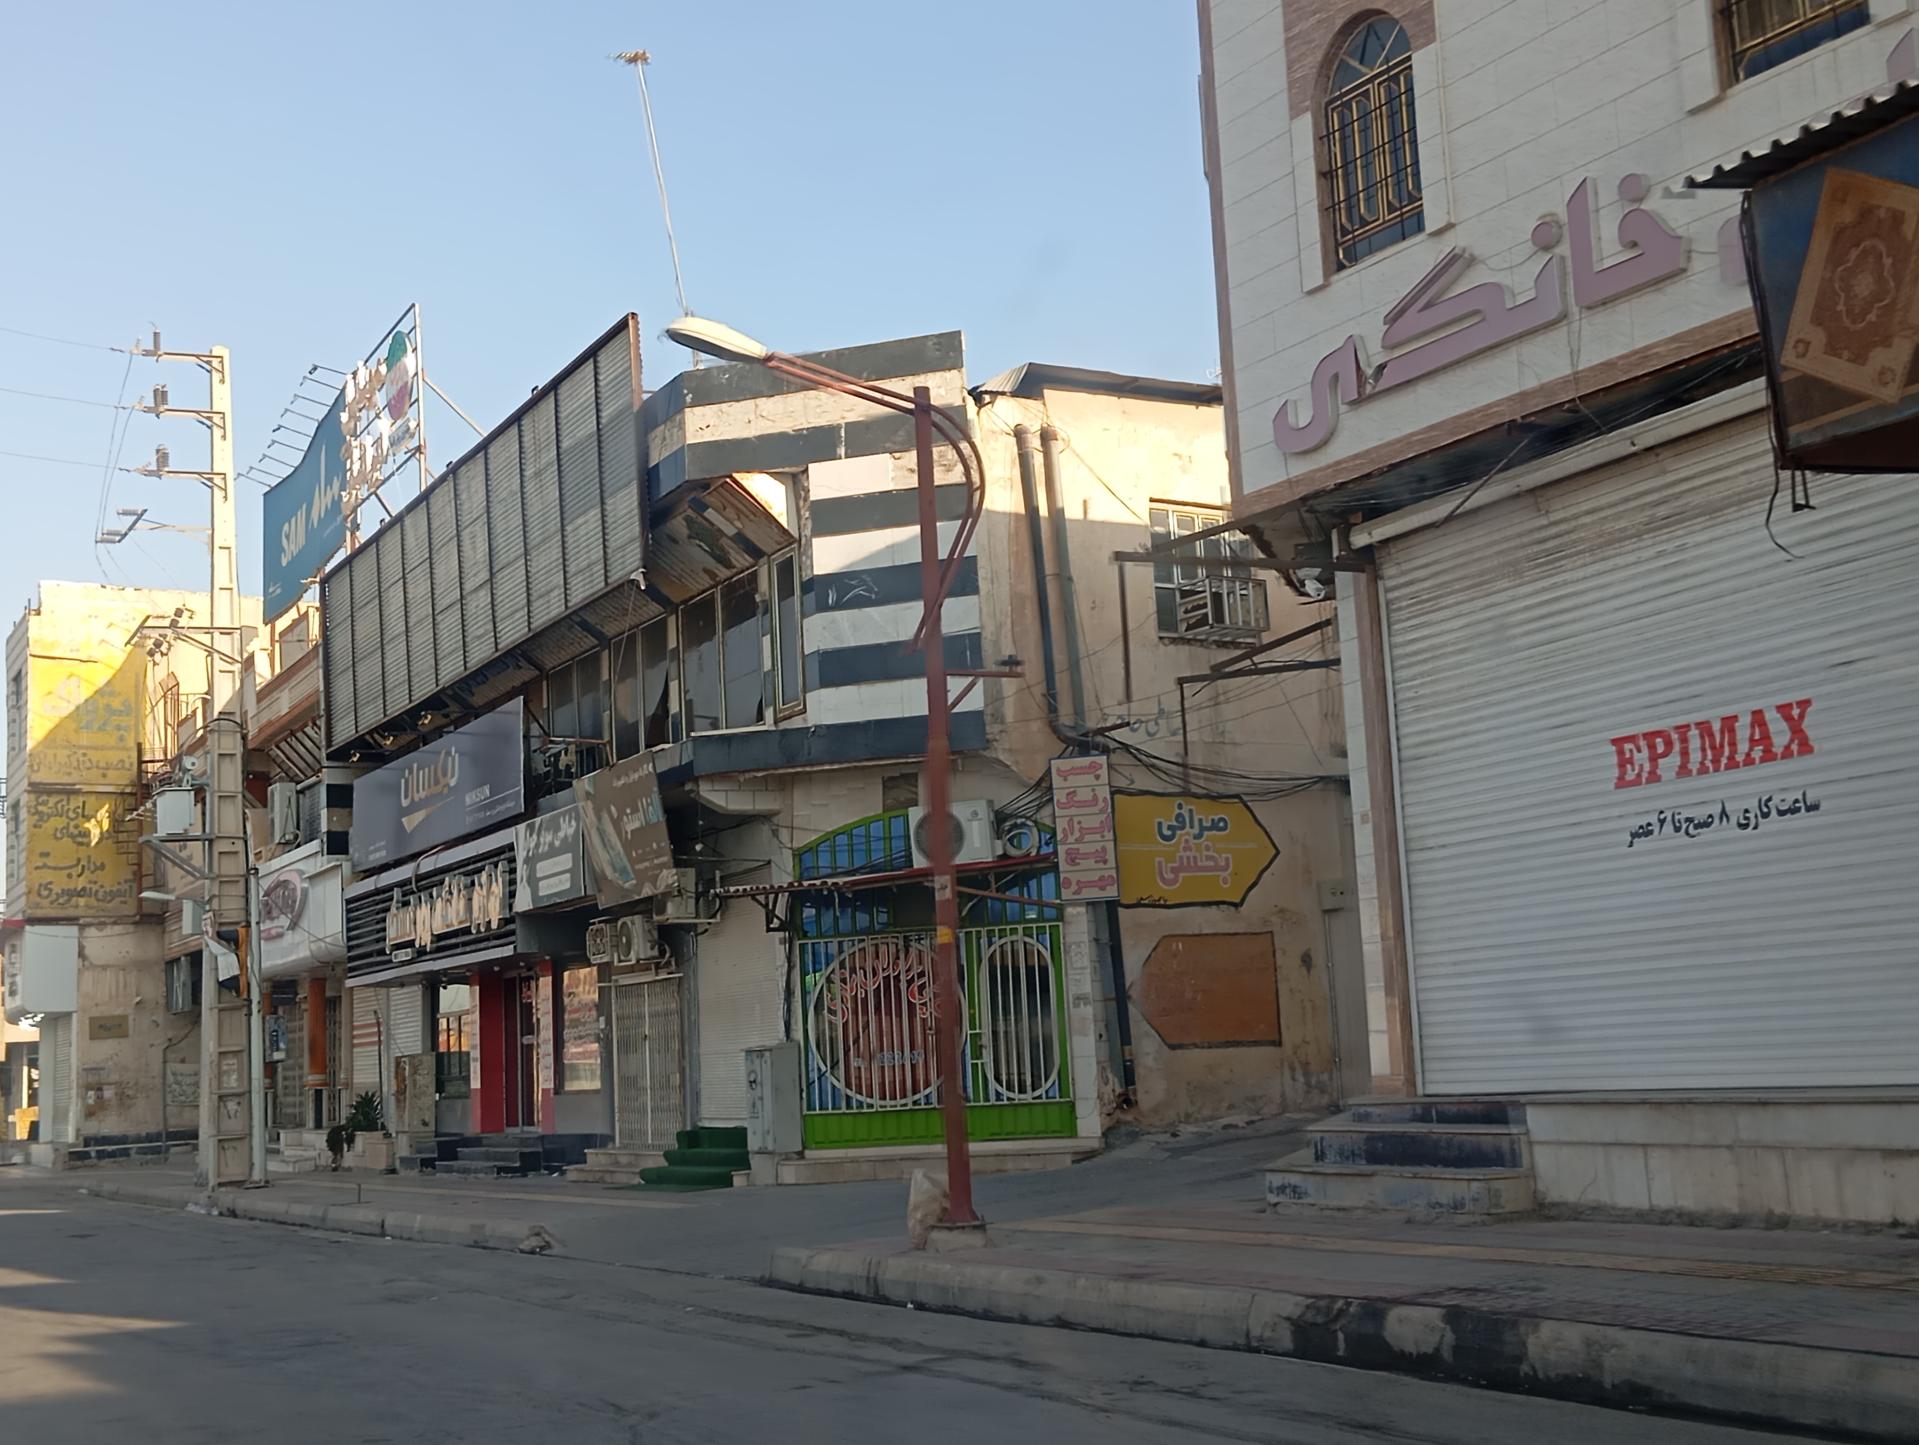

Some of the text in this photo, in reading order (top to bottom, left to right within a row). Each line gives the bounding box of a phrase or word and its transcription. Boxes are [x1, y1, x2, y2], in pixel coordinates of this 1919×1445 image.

[1273, 173, 1690, 454] خانگی
[281, 502, 307, 567] SAM
[1609, 697, 1815, 790] EPIMAX
[1056, 760, 1103, 782] چسب
[1056, 788, 1109, 813] رنگ
[1627, 788, 1821, 848] ساعت کاری ۸ صبح تا ۶ عصر
[1060, 812, 1112, 843] ابزار
[1156, 801, 1230, 842] صرافی
[1065, 845, 1108, 866] پیچ
[1155, 835, 1232, 888] بخشی
[1061, 873, 1116, 895] مهره
